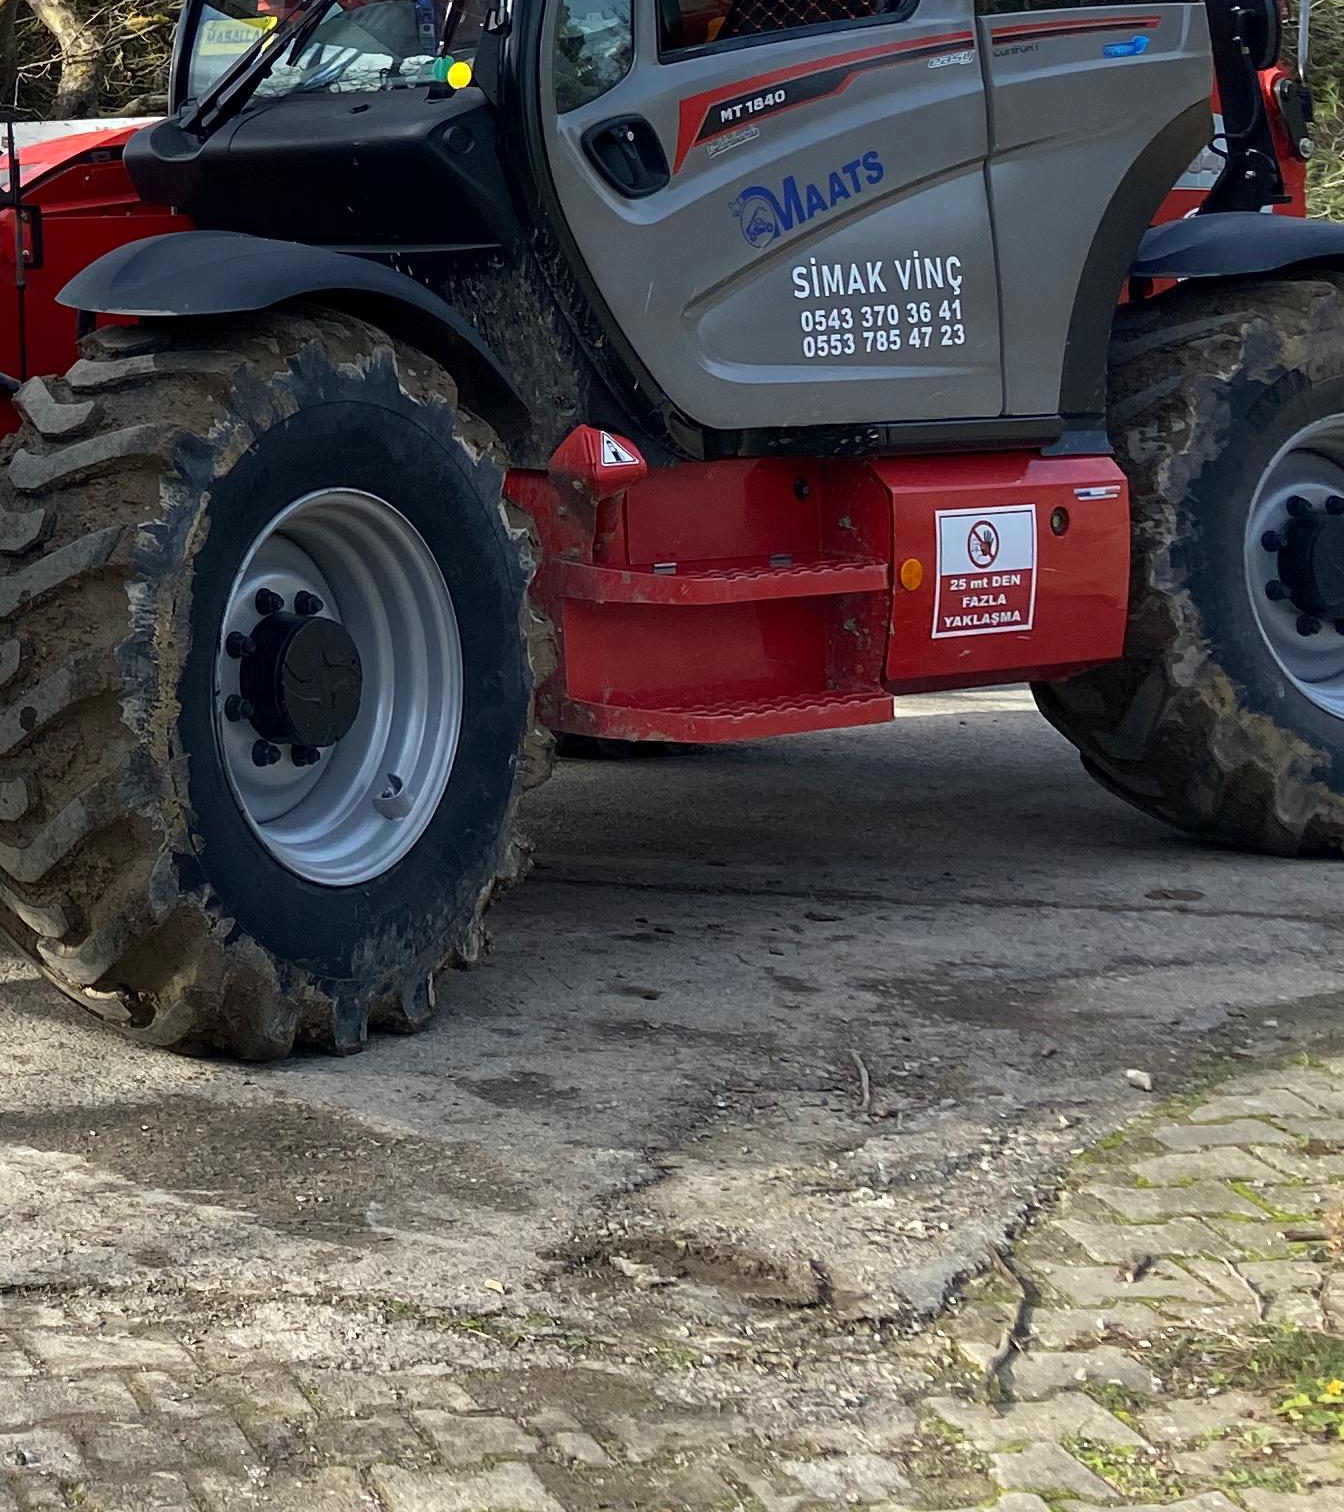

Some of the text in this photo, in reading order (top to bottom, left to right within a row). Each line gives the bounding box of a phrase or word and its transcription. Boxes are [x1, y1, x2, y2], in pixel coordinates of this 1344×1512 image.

[720, 89, 786, 123] MT 1840
[792, 250, 964, 299] SİMAK VİNÇ
[800, 299, 962, 332] 0543 370 36 41
[802, 323, 965, 358] 0553 785 47 23
[950, 575, 1020, 590] 25 mt DEN
[962, 595, 1006, 608] FAZLA
[945, 611, 1021, 626] YAKLAŞMA
